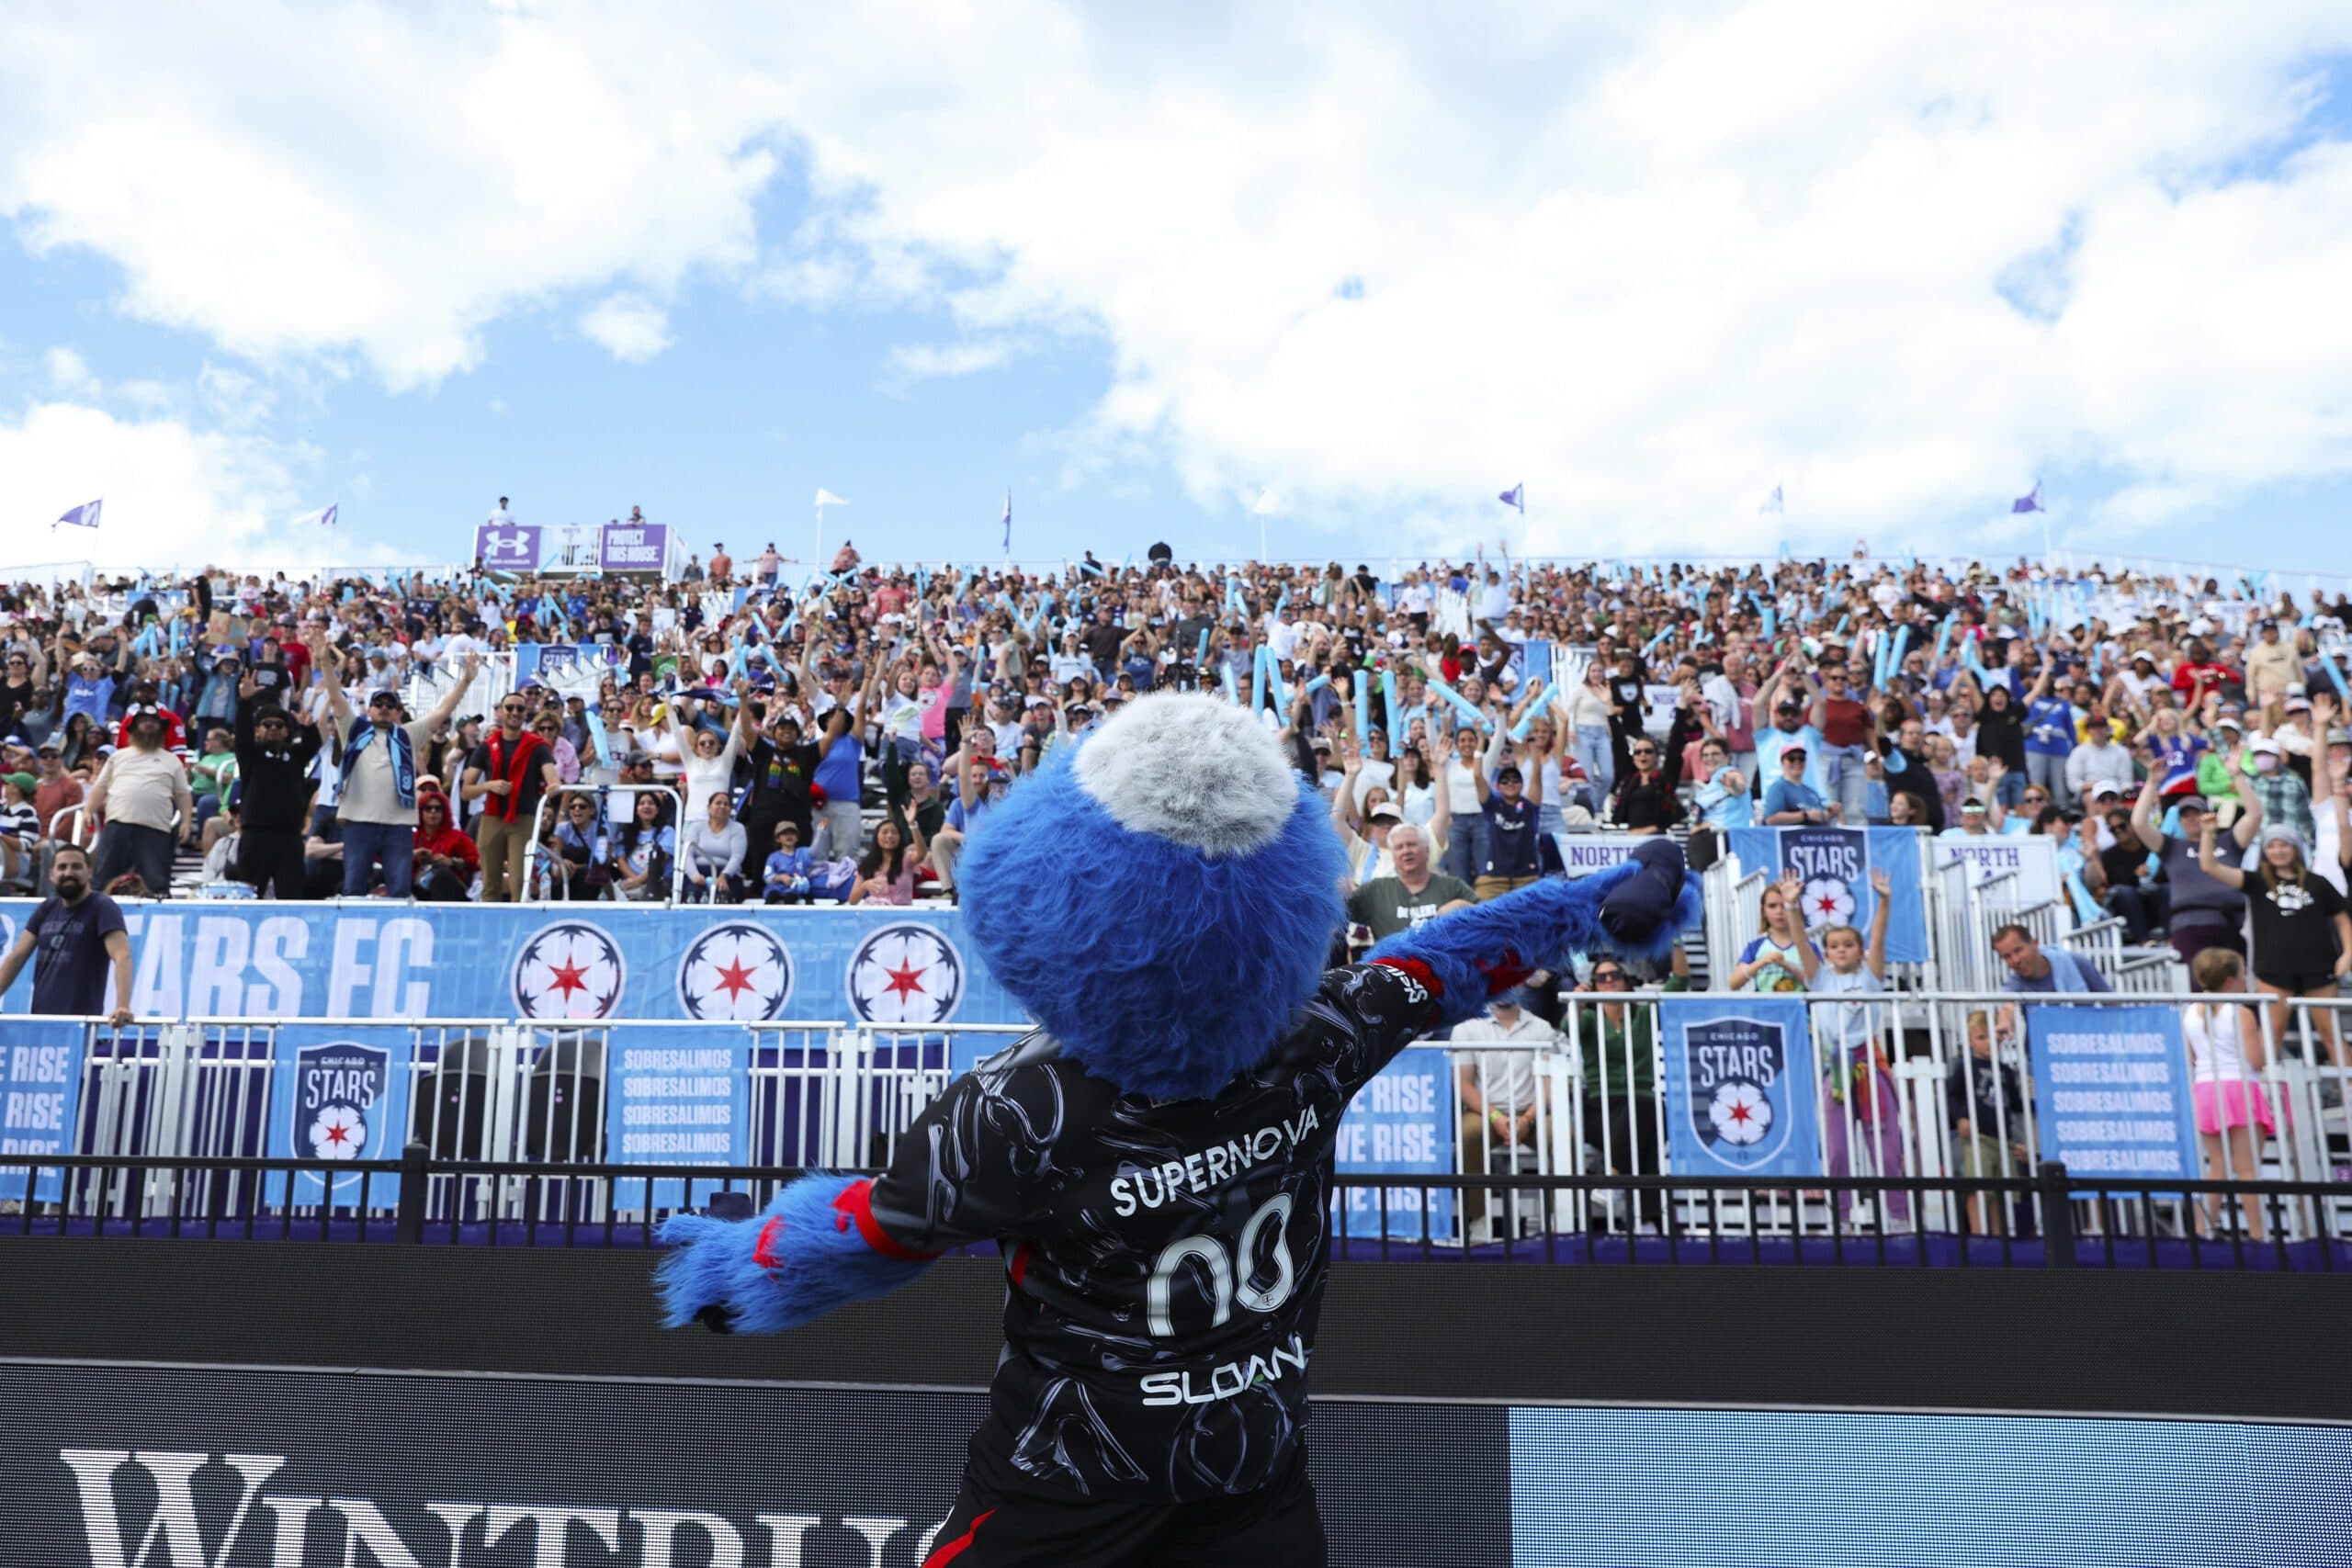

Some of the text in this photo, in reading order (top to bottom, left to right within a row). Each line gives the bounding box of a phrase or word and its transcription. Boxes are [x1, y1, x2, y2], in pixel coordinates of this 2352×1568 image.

[1790, 845, 1859, 883] STARS
[1950, 846, 2020, 867] NORTH
[104, 914, 311, 1018] ARS
[326, 917, 435, 1019] FC
[1710, 1032, 1759, 1041] CHICAGO
[2046, 1032, 2166, 1055] SOBRESALIMOS
[10, 1045, 71, 1083] RISE
[320, 1056, 366, 1066] CHICAGO
[623, 1049, 732, 1070] SOBRESALIMOS
[1699, 1045, 1775, 1088] STARS
[2050, 1062, 2170, 1083] SOBRESALIMOS
[305, 1069, 376, 1110] STARS
[623, 1077, 731, 1098] SOBRESALIMOS
[1372, 1075, 1435, 1113] RISE
[5, 1091, 66, 1130] RISE
[2052, 1090, 2174, 1112] SOBRESALIMOS
[623, 1105, 731, 1126] SOBRESALIMOS
[1373, 1123, 1437, 1162] RISE
[2056, 1120, 2177, 1143] SOBRESALIMOS
[622, 1133, 731, 1154] SOBRESALIMOS
[1109, 1103, 1320, 1219] SUPERNOVA
[2058, 1149, 2181, 1172] SOBRESALIMOS
[1139, 1337, 1310, 1407] SLOAN
[59, 1449, 952, 1568] WINTRU
